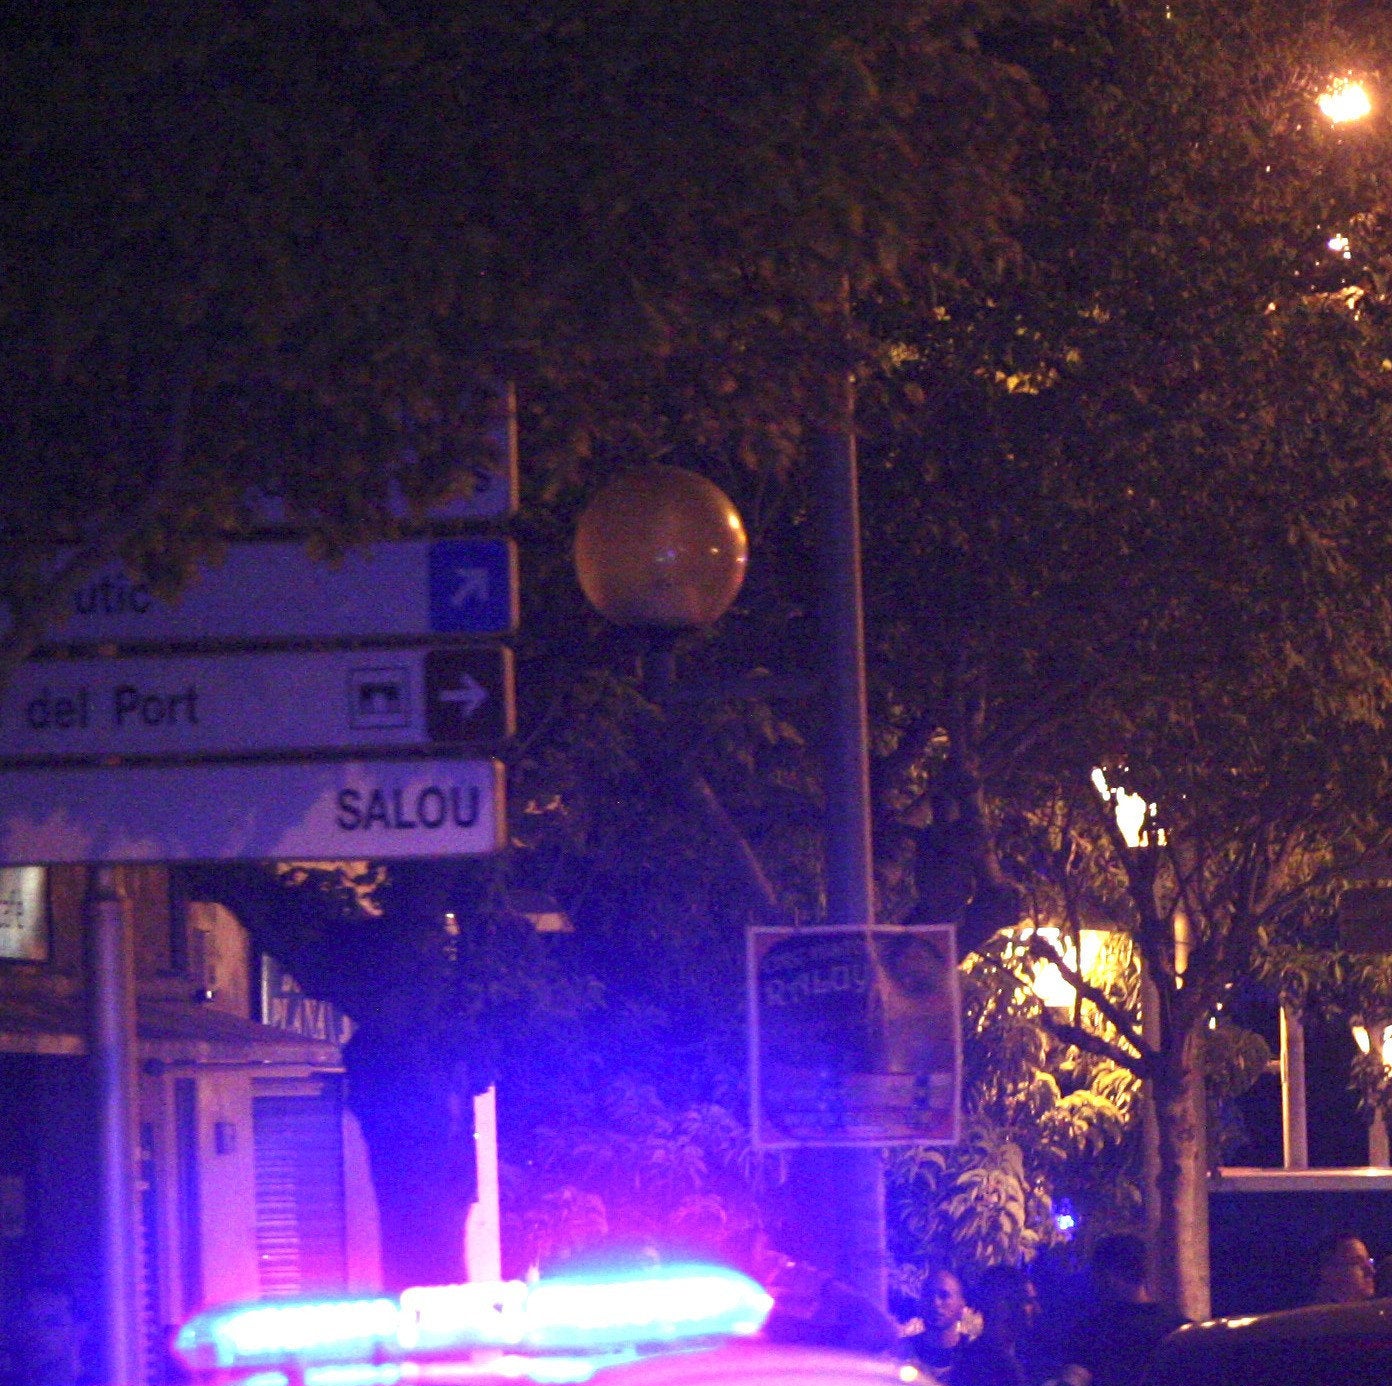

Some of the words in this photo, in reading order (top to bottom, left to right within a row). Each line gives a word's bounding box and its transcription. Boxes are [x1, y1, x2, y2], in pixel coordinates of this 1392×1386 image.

[75, 574, 152, 615] utic
[26, 687, 89, 729] del
[114, 685, 200, 727] Port
[335, 786, 480, 831] SALOU
